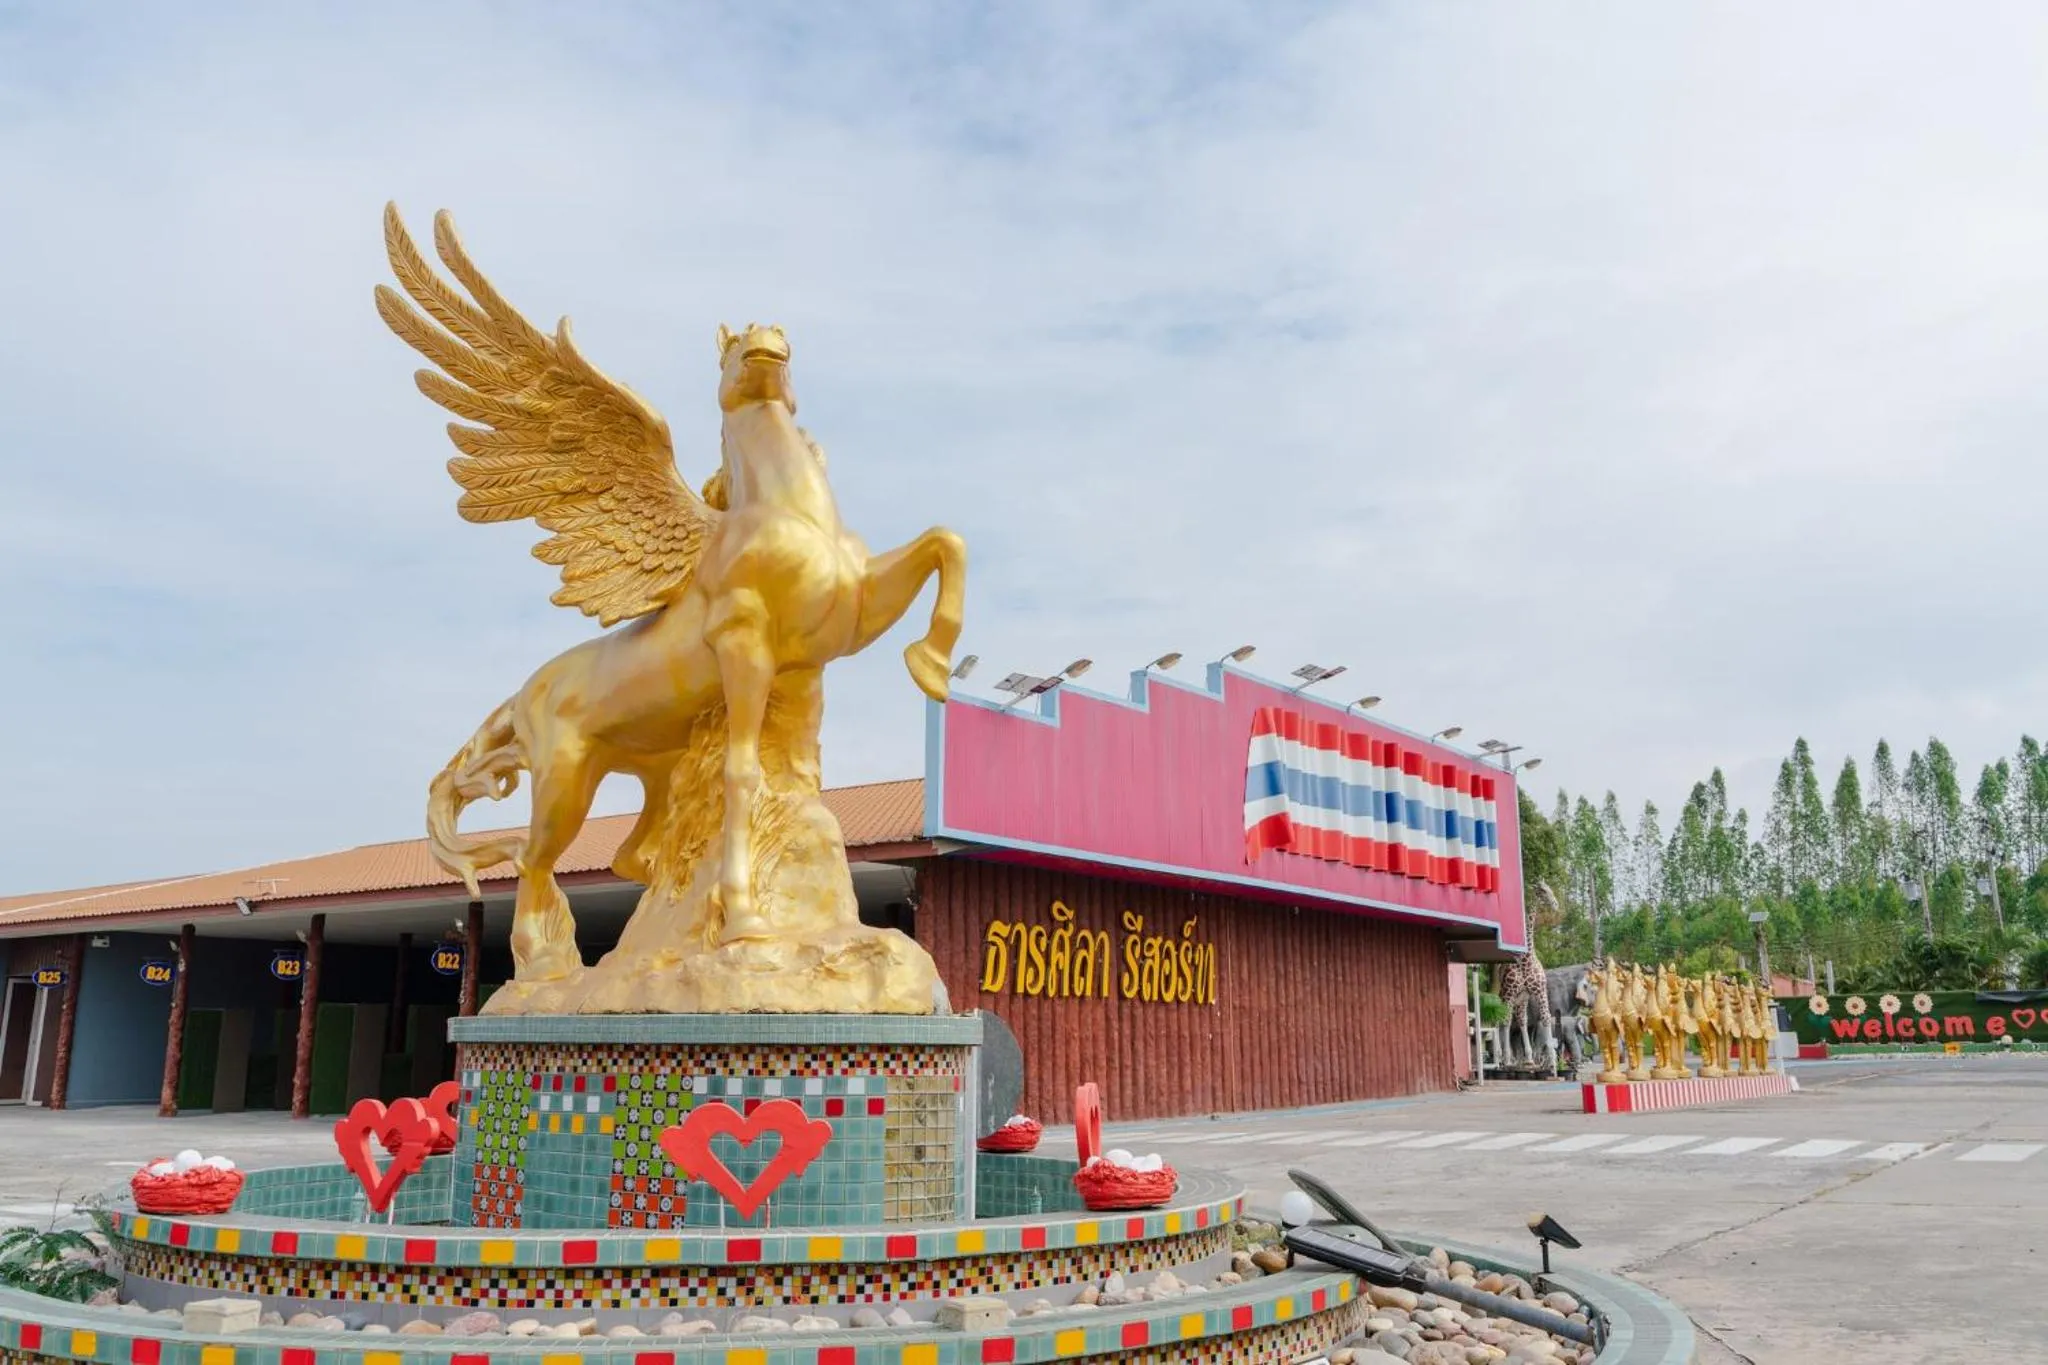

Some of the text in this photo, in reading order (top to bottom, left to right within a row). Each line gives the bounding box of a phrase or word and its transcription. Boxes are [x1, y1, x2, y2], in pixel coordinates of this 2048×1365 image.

[437, 952, 460, 969] B22
[1122, 910, 1216, 1005] รีสอร์ท
[145, 965, 171, 982] B24
[277, 959, 300, 975] B23
[37, 971, 61, 984] B25
[1830, 1011, 2007, 1038] welcome
